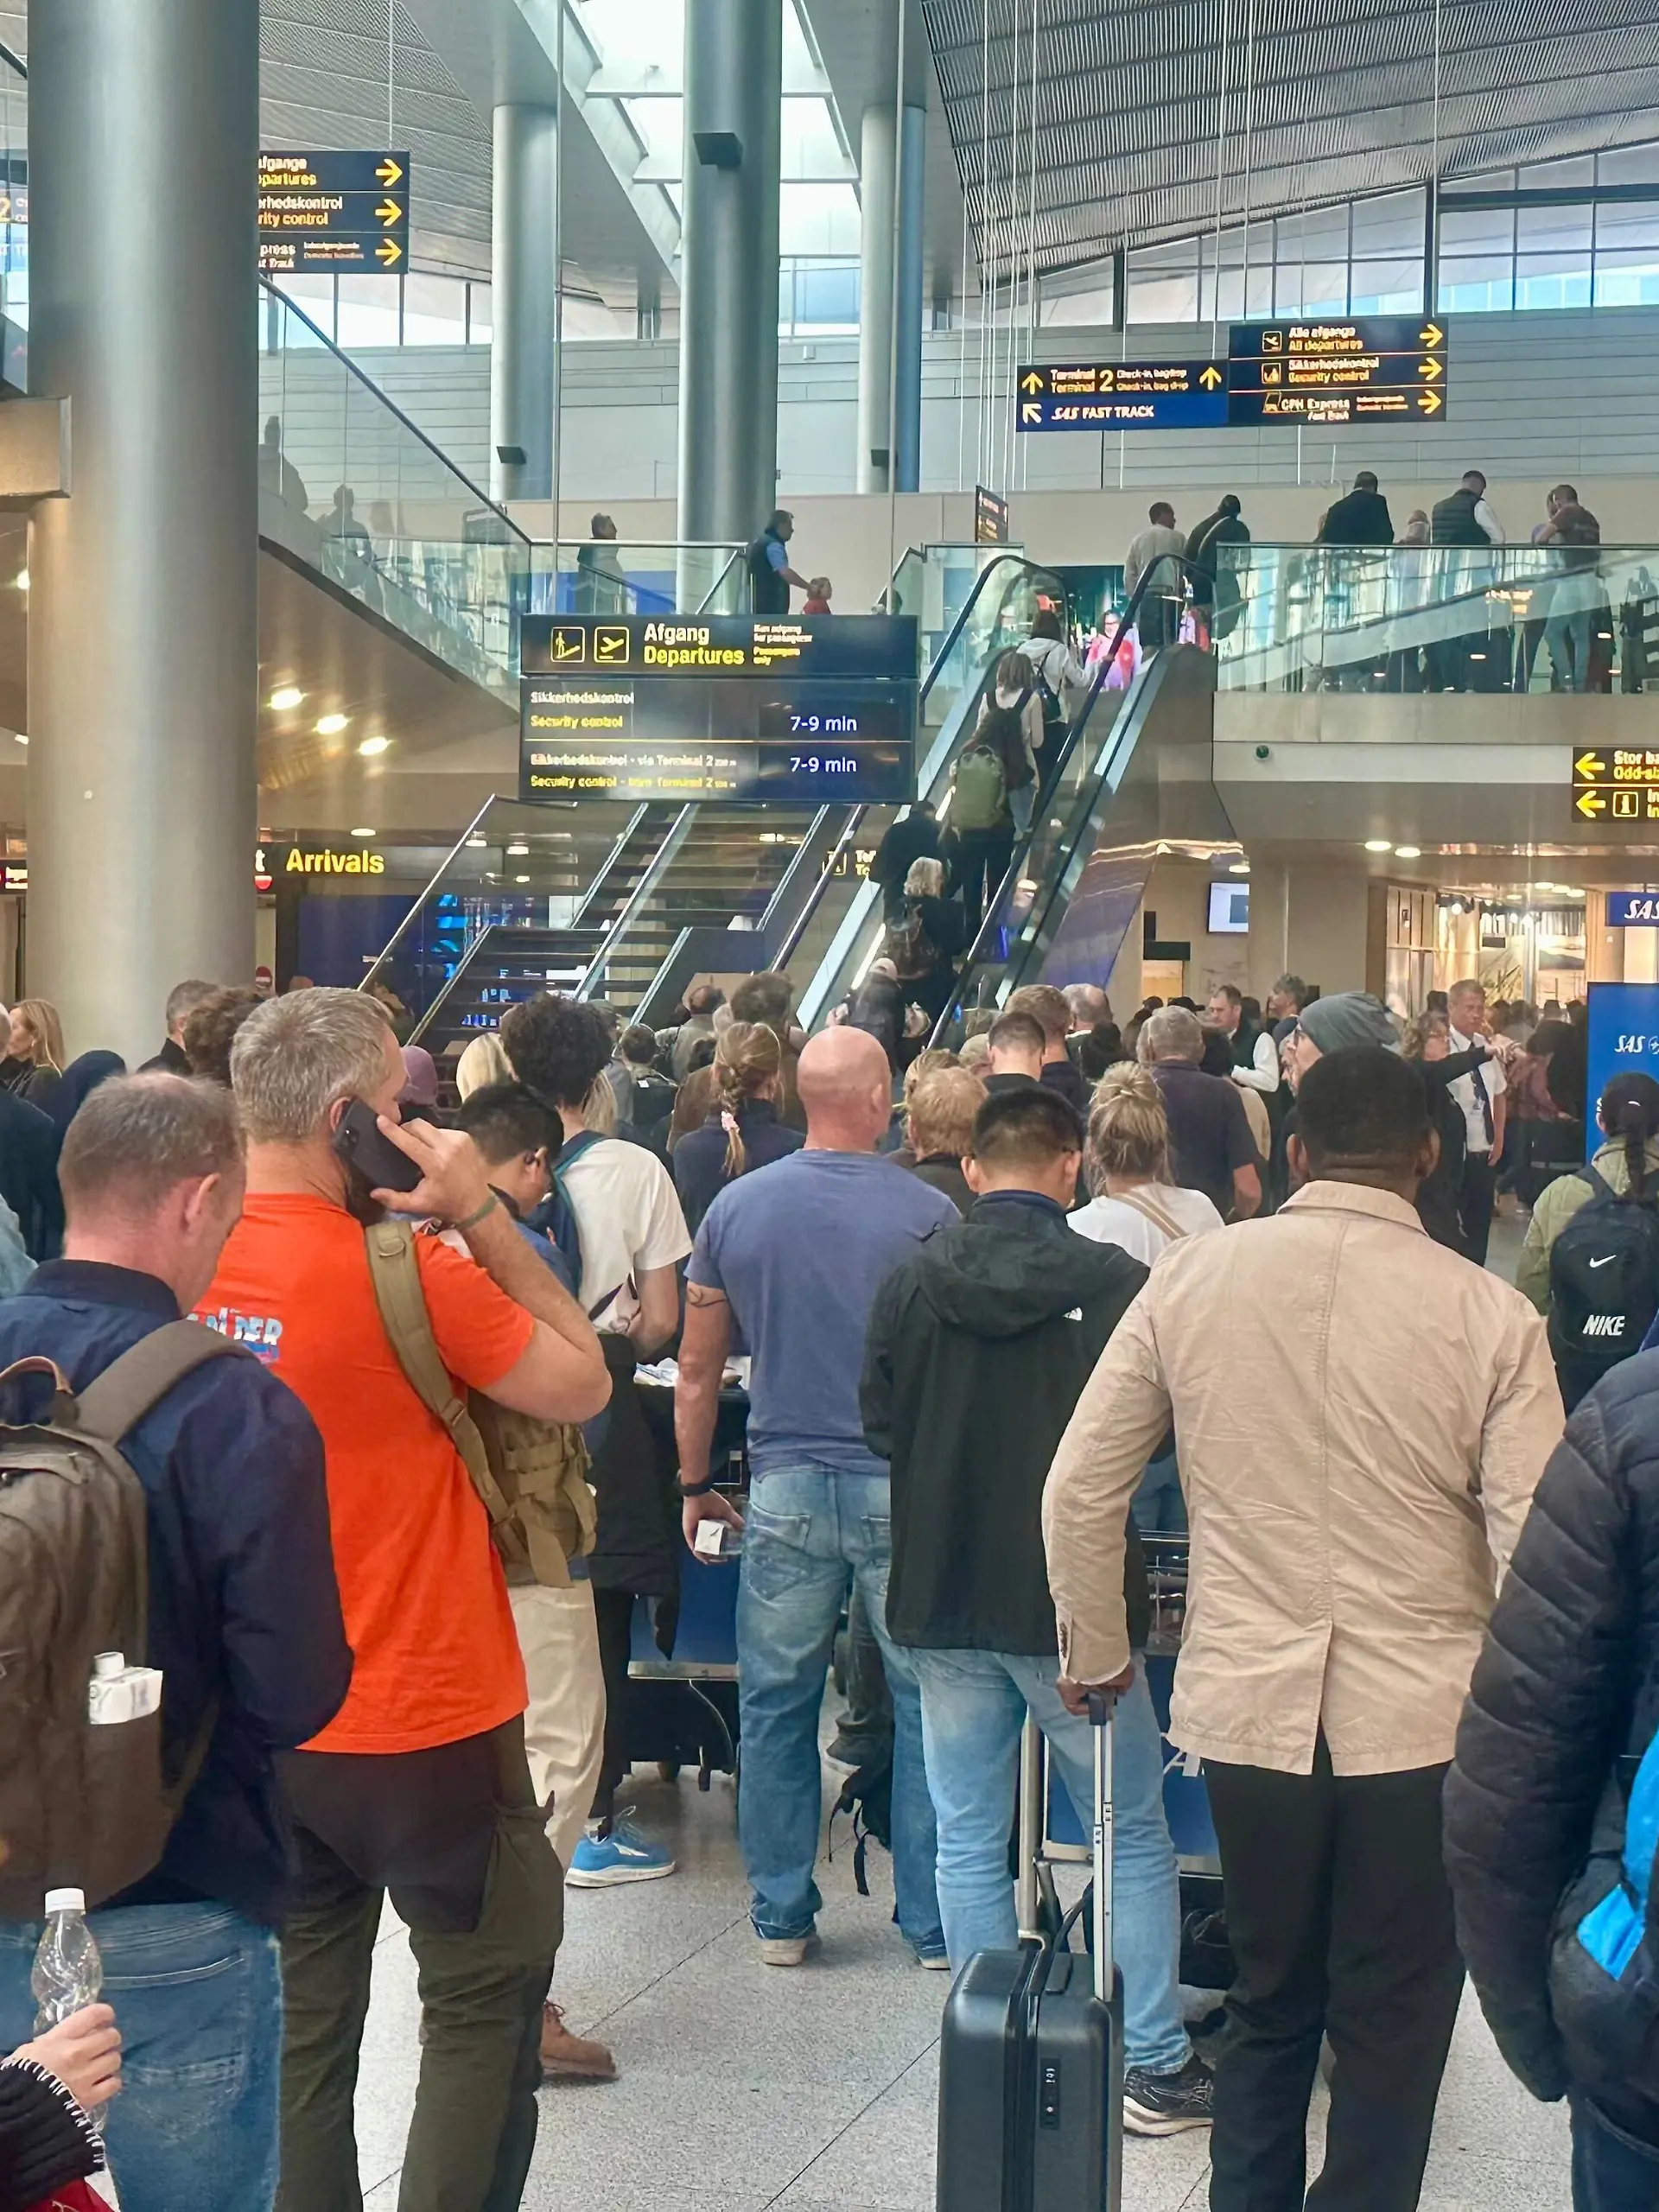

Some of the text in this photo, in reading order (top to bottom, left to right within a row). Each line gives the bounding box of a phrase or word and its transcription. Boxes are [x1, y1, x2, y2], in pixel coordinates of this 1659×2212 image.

[283, 213, 328, 225] control
[1305, 340, 1363, 352] departures
[1050, 368, 1096, 381] Terminal
[1099, 369, 1114, 392] 2
[1288, 370, 1370, 384] Security control
[1051, 381, 1095, 393] Terminal
[1051, 404, 1154, 420] SAS FAST TRACK
[644, 623, 709, 645] Afgang
[644, 645, 745, 667] Departures
[531, 692, 635, 704] Sikkerhedskontrol
[531, 715, 623, 729] Security control
[790, 715, 857, 732] 7-9 min
[656, 754, 702, 766] Terminal
[706, 754, 714, 766] 2
[790, 757, 857, 772] 7-9 min
[1614, 750, 1643, 765] Stor
[531, 775, 575, 789] Security
[578, 776, 617, 787] control
[658, 777, 702, 787] Terminal
[706, 777, 714, 788] 2
[286, 848, 385, 874] Arrivals
[1614, 1035, 1646, 1053] SAS
[1582, 1314, 1625, 1336] NIKE
